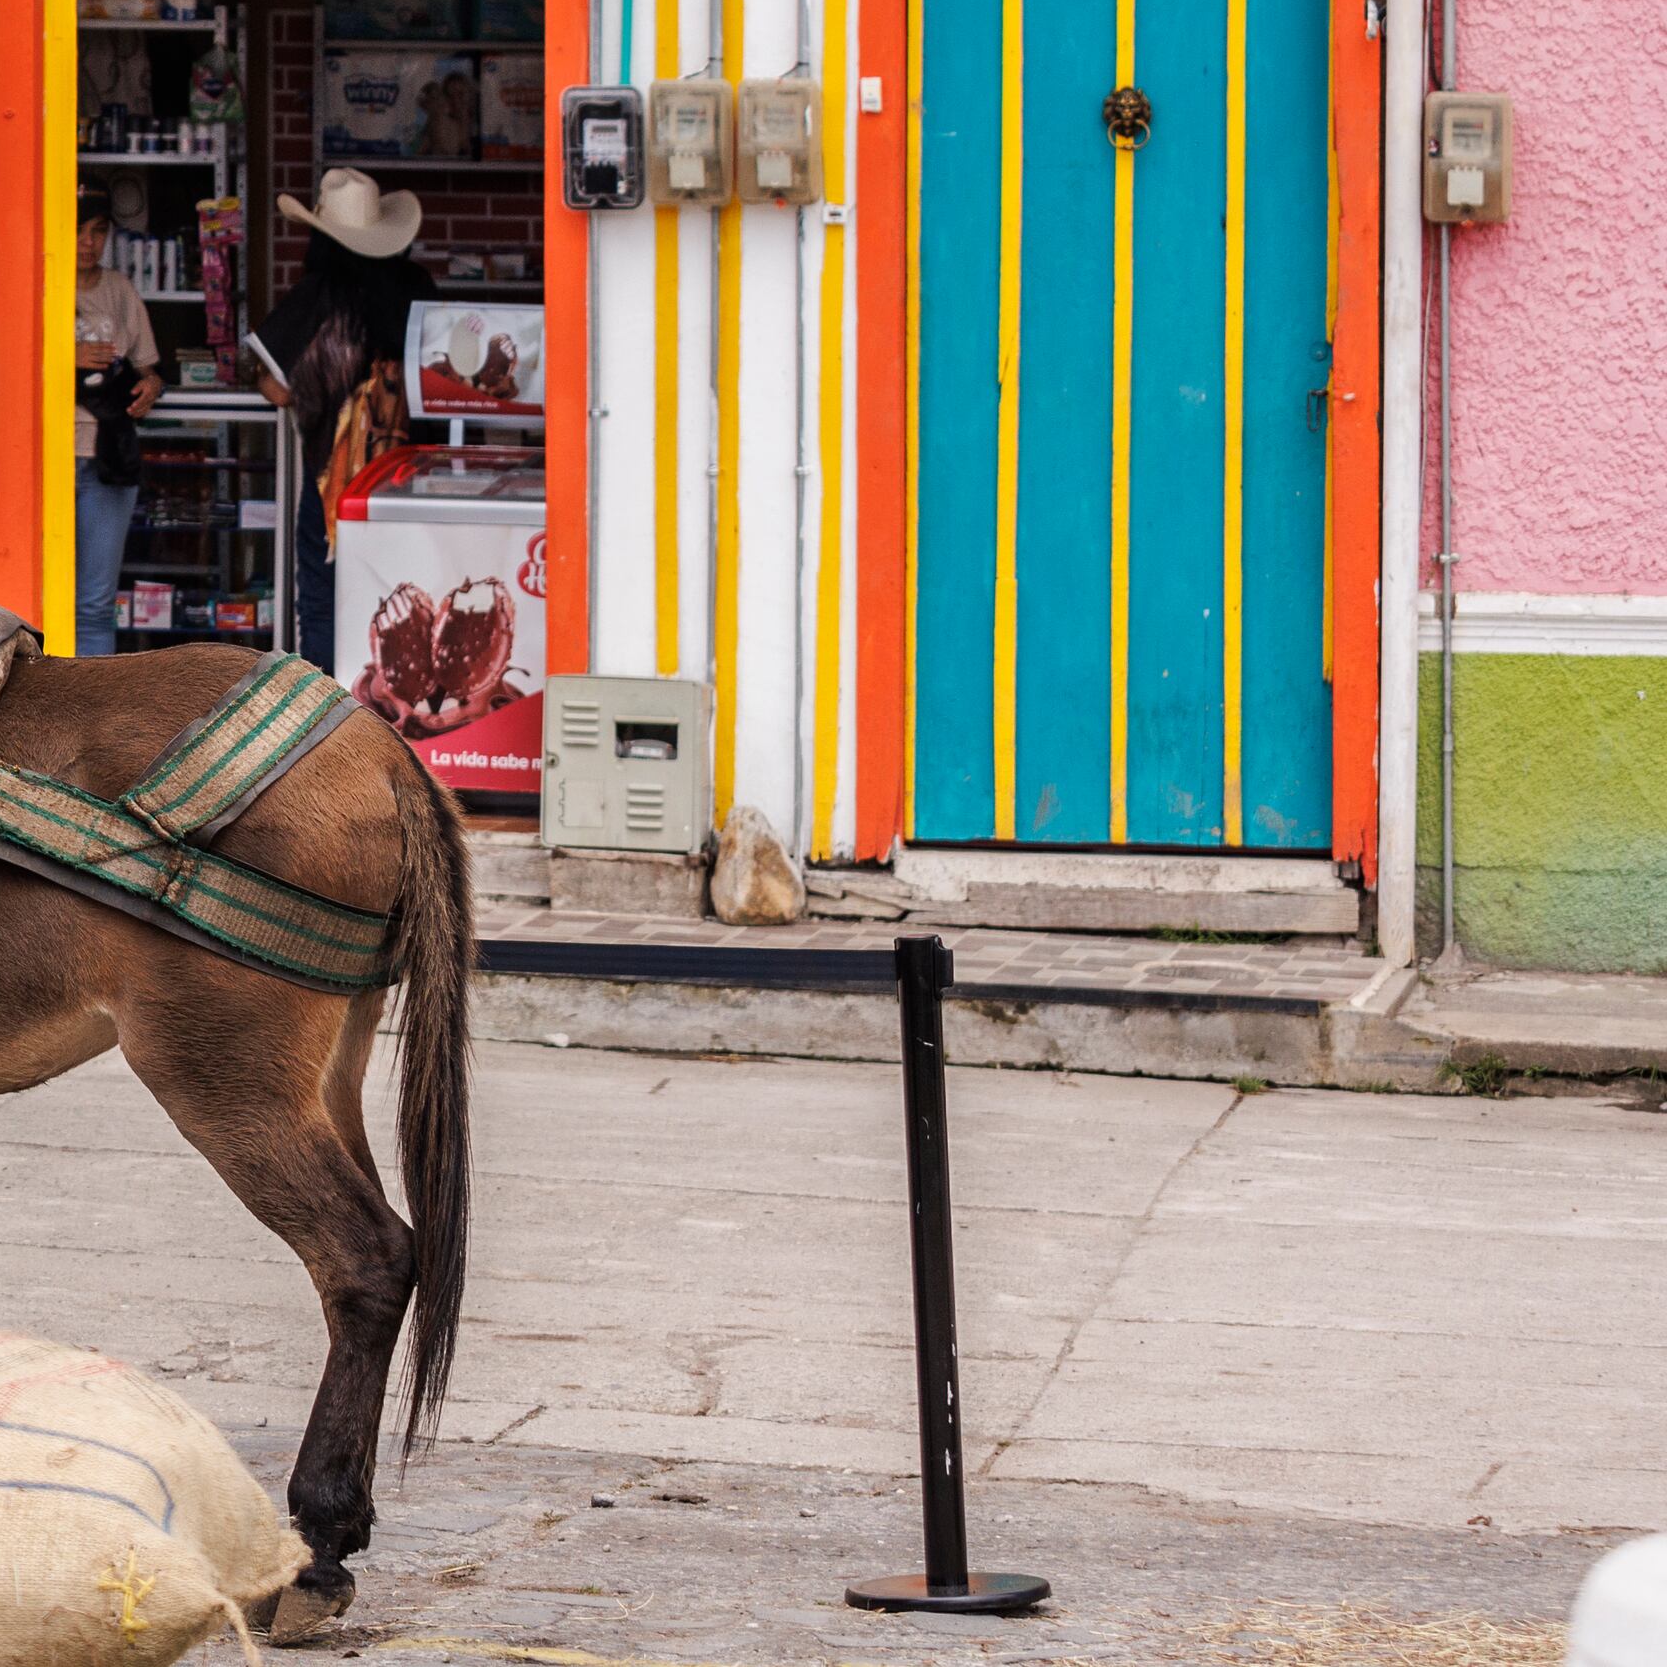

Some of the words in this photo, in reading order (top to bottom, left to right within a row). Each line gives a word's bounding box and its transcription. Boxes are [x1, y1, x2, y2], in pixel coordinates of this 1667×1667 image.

[430, 749, 452, 766] La
[453, 750, 488, 768] vida
[490, 753, 529, 770] sabe
